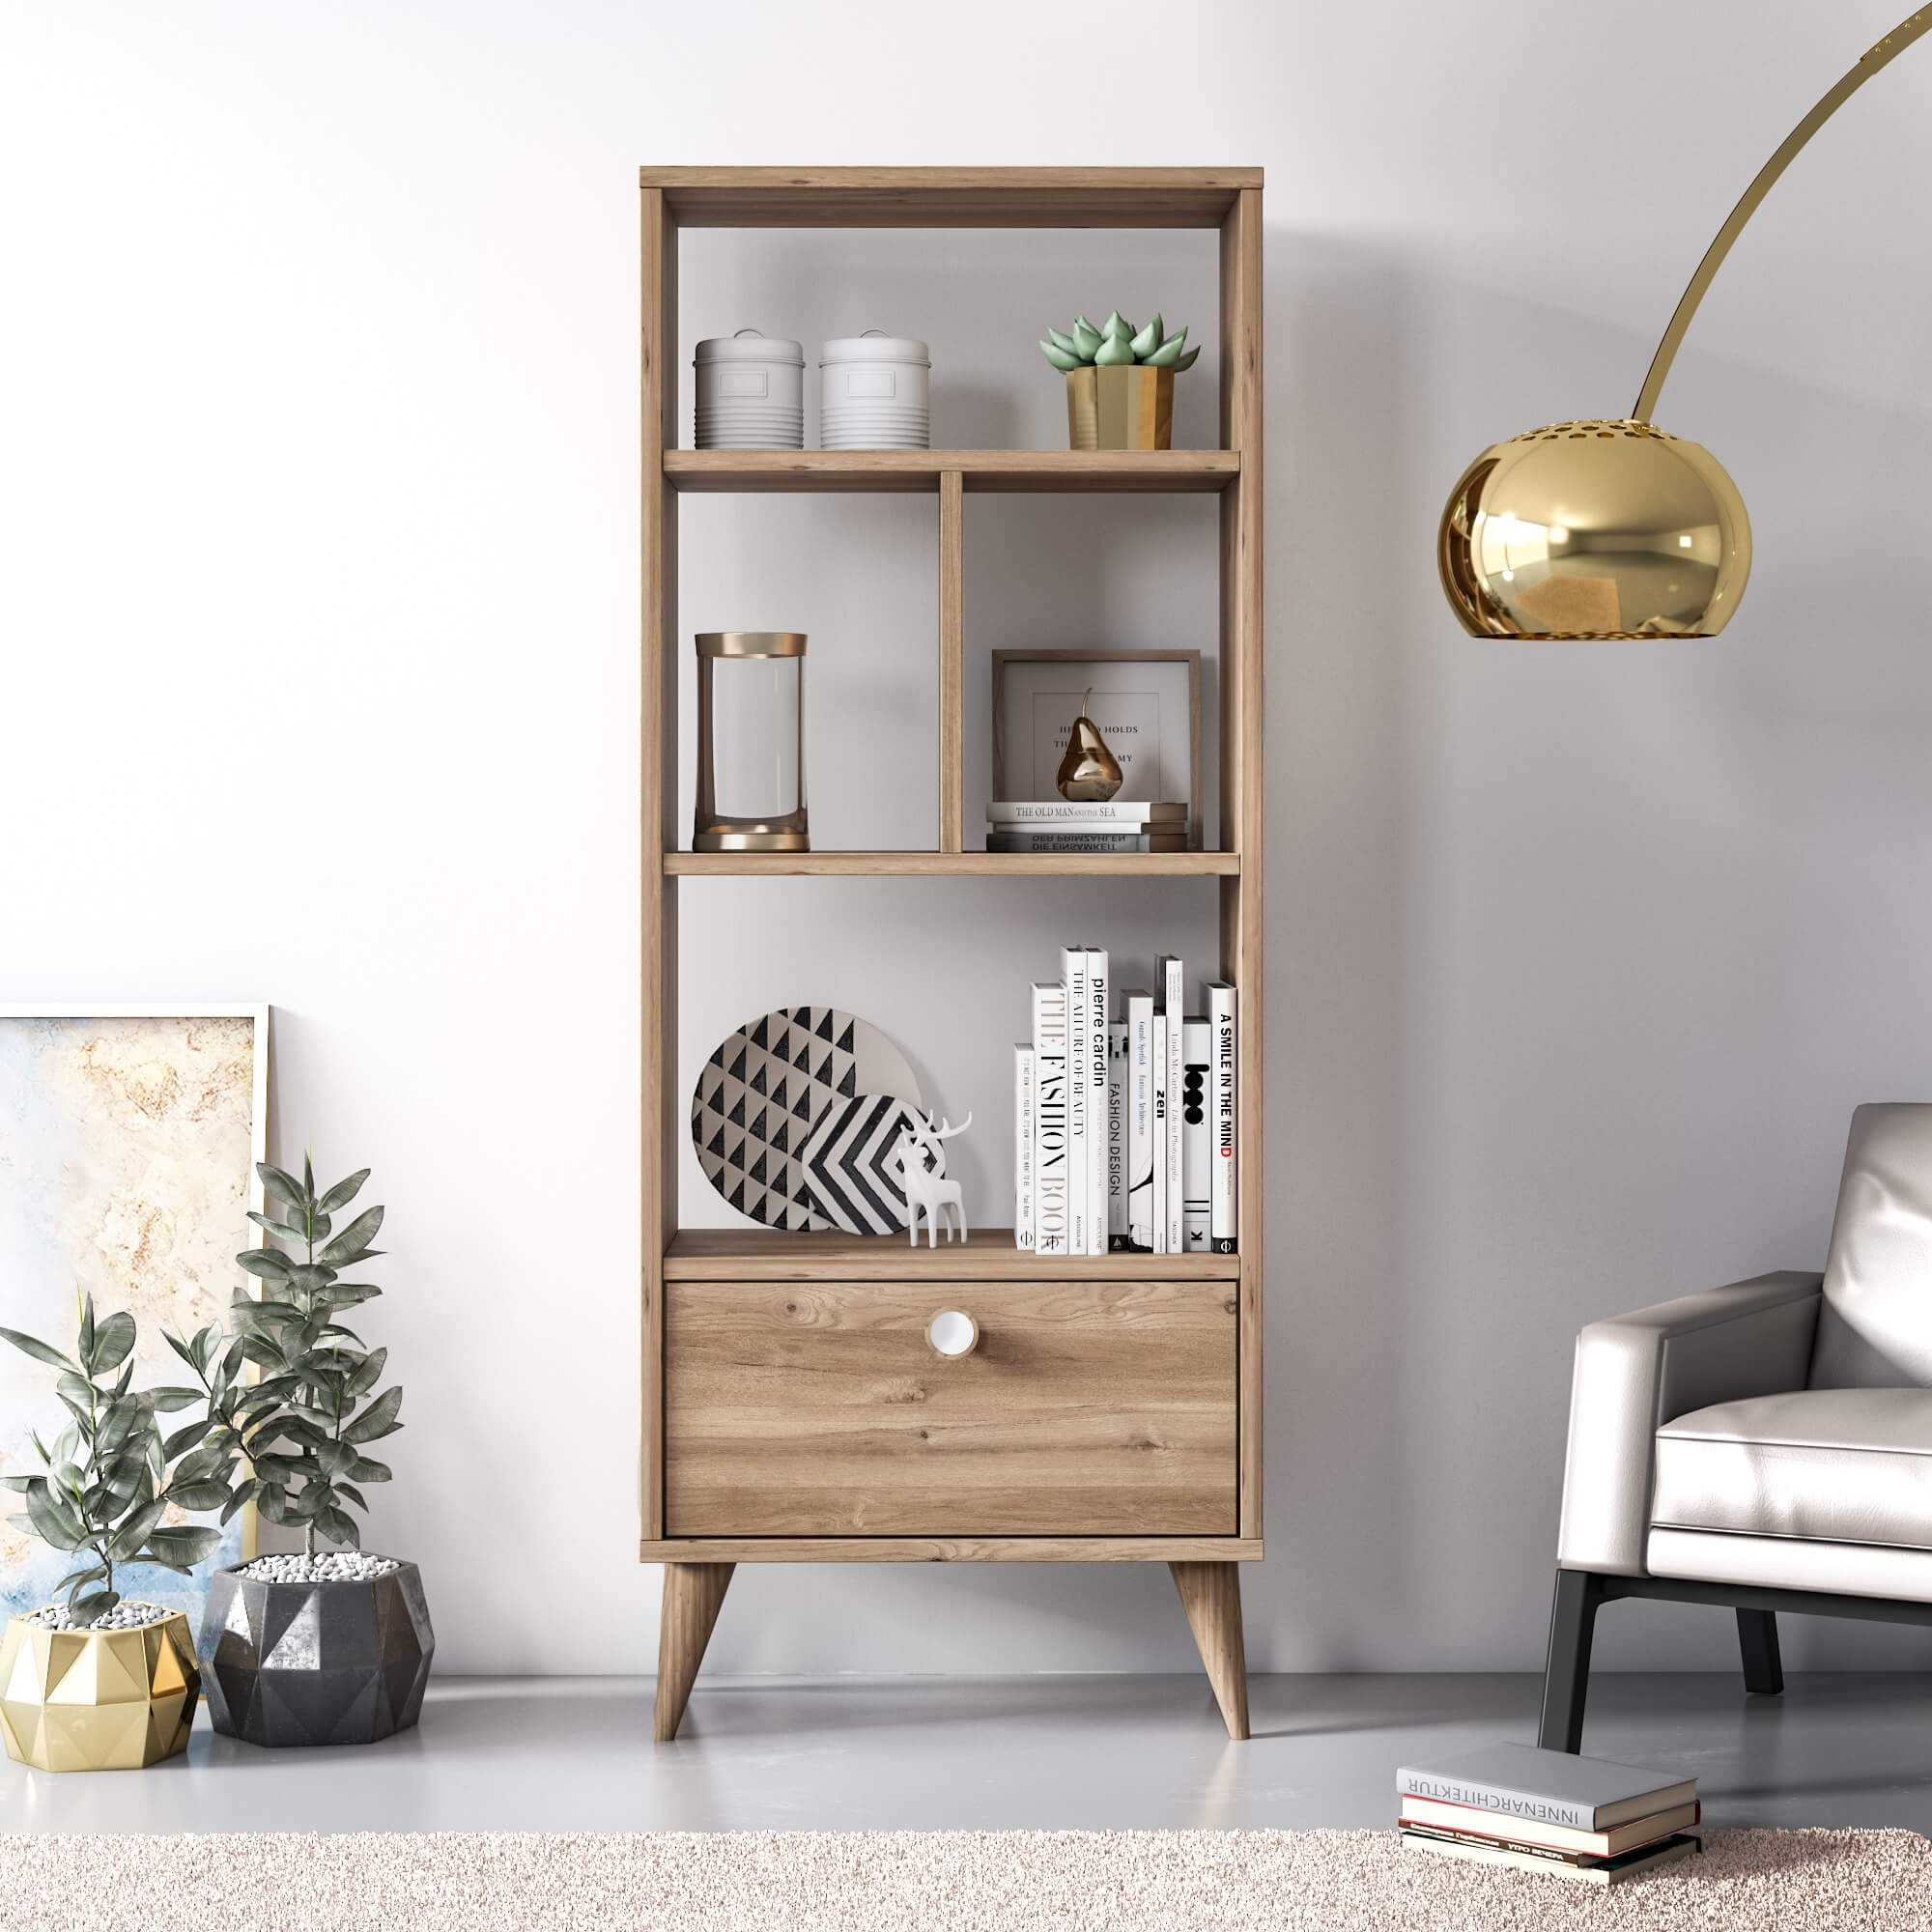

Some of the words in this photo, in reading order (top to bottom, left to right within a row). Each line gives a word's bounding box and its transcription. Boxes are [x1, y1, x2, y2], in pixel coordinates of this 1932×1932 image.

[1016, 807, 1034, 817] THE
[1036, 807, 1053, 817] OLD
[1055, 807, 1074, 817] MAN
[1099, 807, 1116, 817] SEA
[1074, 970, 1084, 998] THE
[1092, 979, 1106, 1028] pierre
[1041, 993, 1065, 1048] THE
[1074, 1003, 1084, 1057] ALLURE
[1221, 1013, 1232, 1023] A
[1074, 1061, 1084, 1079] OF
[1094, 1034, 1106, 1088] cardin
[1221, 1027, 1232, 1068] SMILE
[1156, 1090, 1165, 1119] zen
[1221, 1073, 1232, 1088] IN
[1221, 1092, 1232, 1117] THE
[1041, 1056, 1065, 1167] FASHION
[1074, 1082, 1084, 1138] BEAUTY
[1109, 1083, 1121, 1142] FASHION
[1221, 1121, 1232, 1157] MIND
[1109, 1147, 1121, 1196] DESIGN
[1041, 1177, 1065, 1250] BOOK
[1408, 1777, 1579, 1826] INNENARCHITEKTUR
